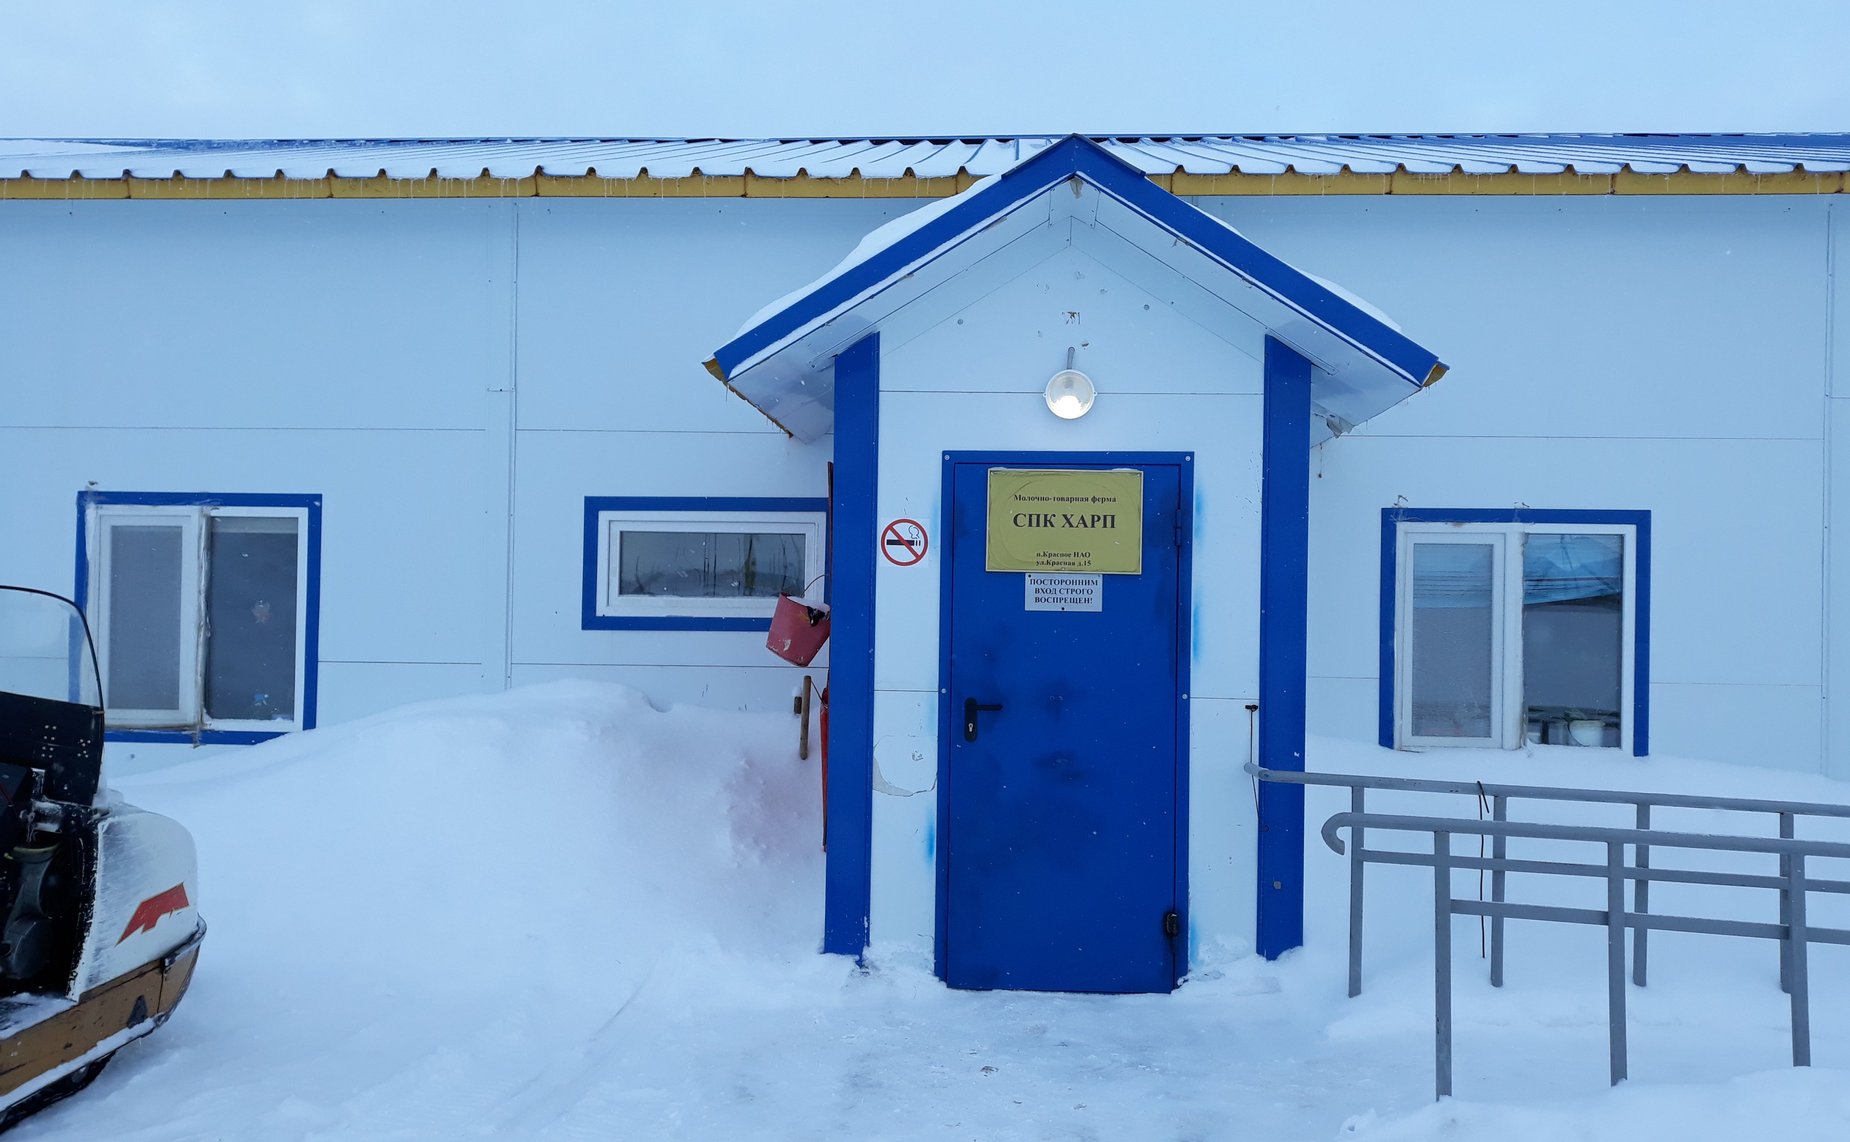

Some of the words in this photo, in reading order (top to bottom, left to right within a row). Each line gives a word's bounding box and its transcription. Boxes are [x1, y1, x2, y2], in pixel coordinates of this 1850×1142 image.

[1013, 494, 1089, 503] Молочно-товарная
[1091, 495, 1117, 504] ферма
[1013, 513, 1056, 528] СПК
[1061, 513, 1116, 529] ХАРП
[1036, 559, 1076, 567] ул.Красная
[1029, 578, 1098, 586] ПОСТОРОННИМ
[1034, 587, 1057, 595] ВХОД
[1034, 596, 1093, 605] ВОСПРЕЩЕН!
